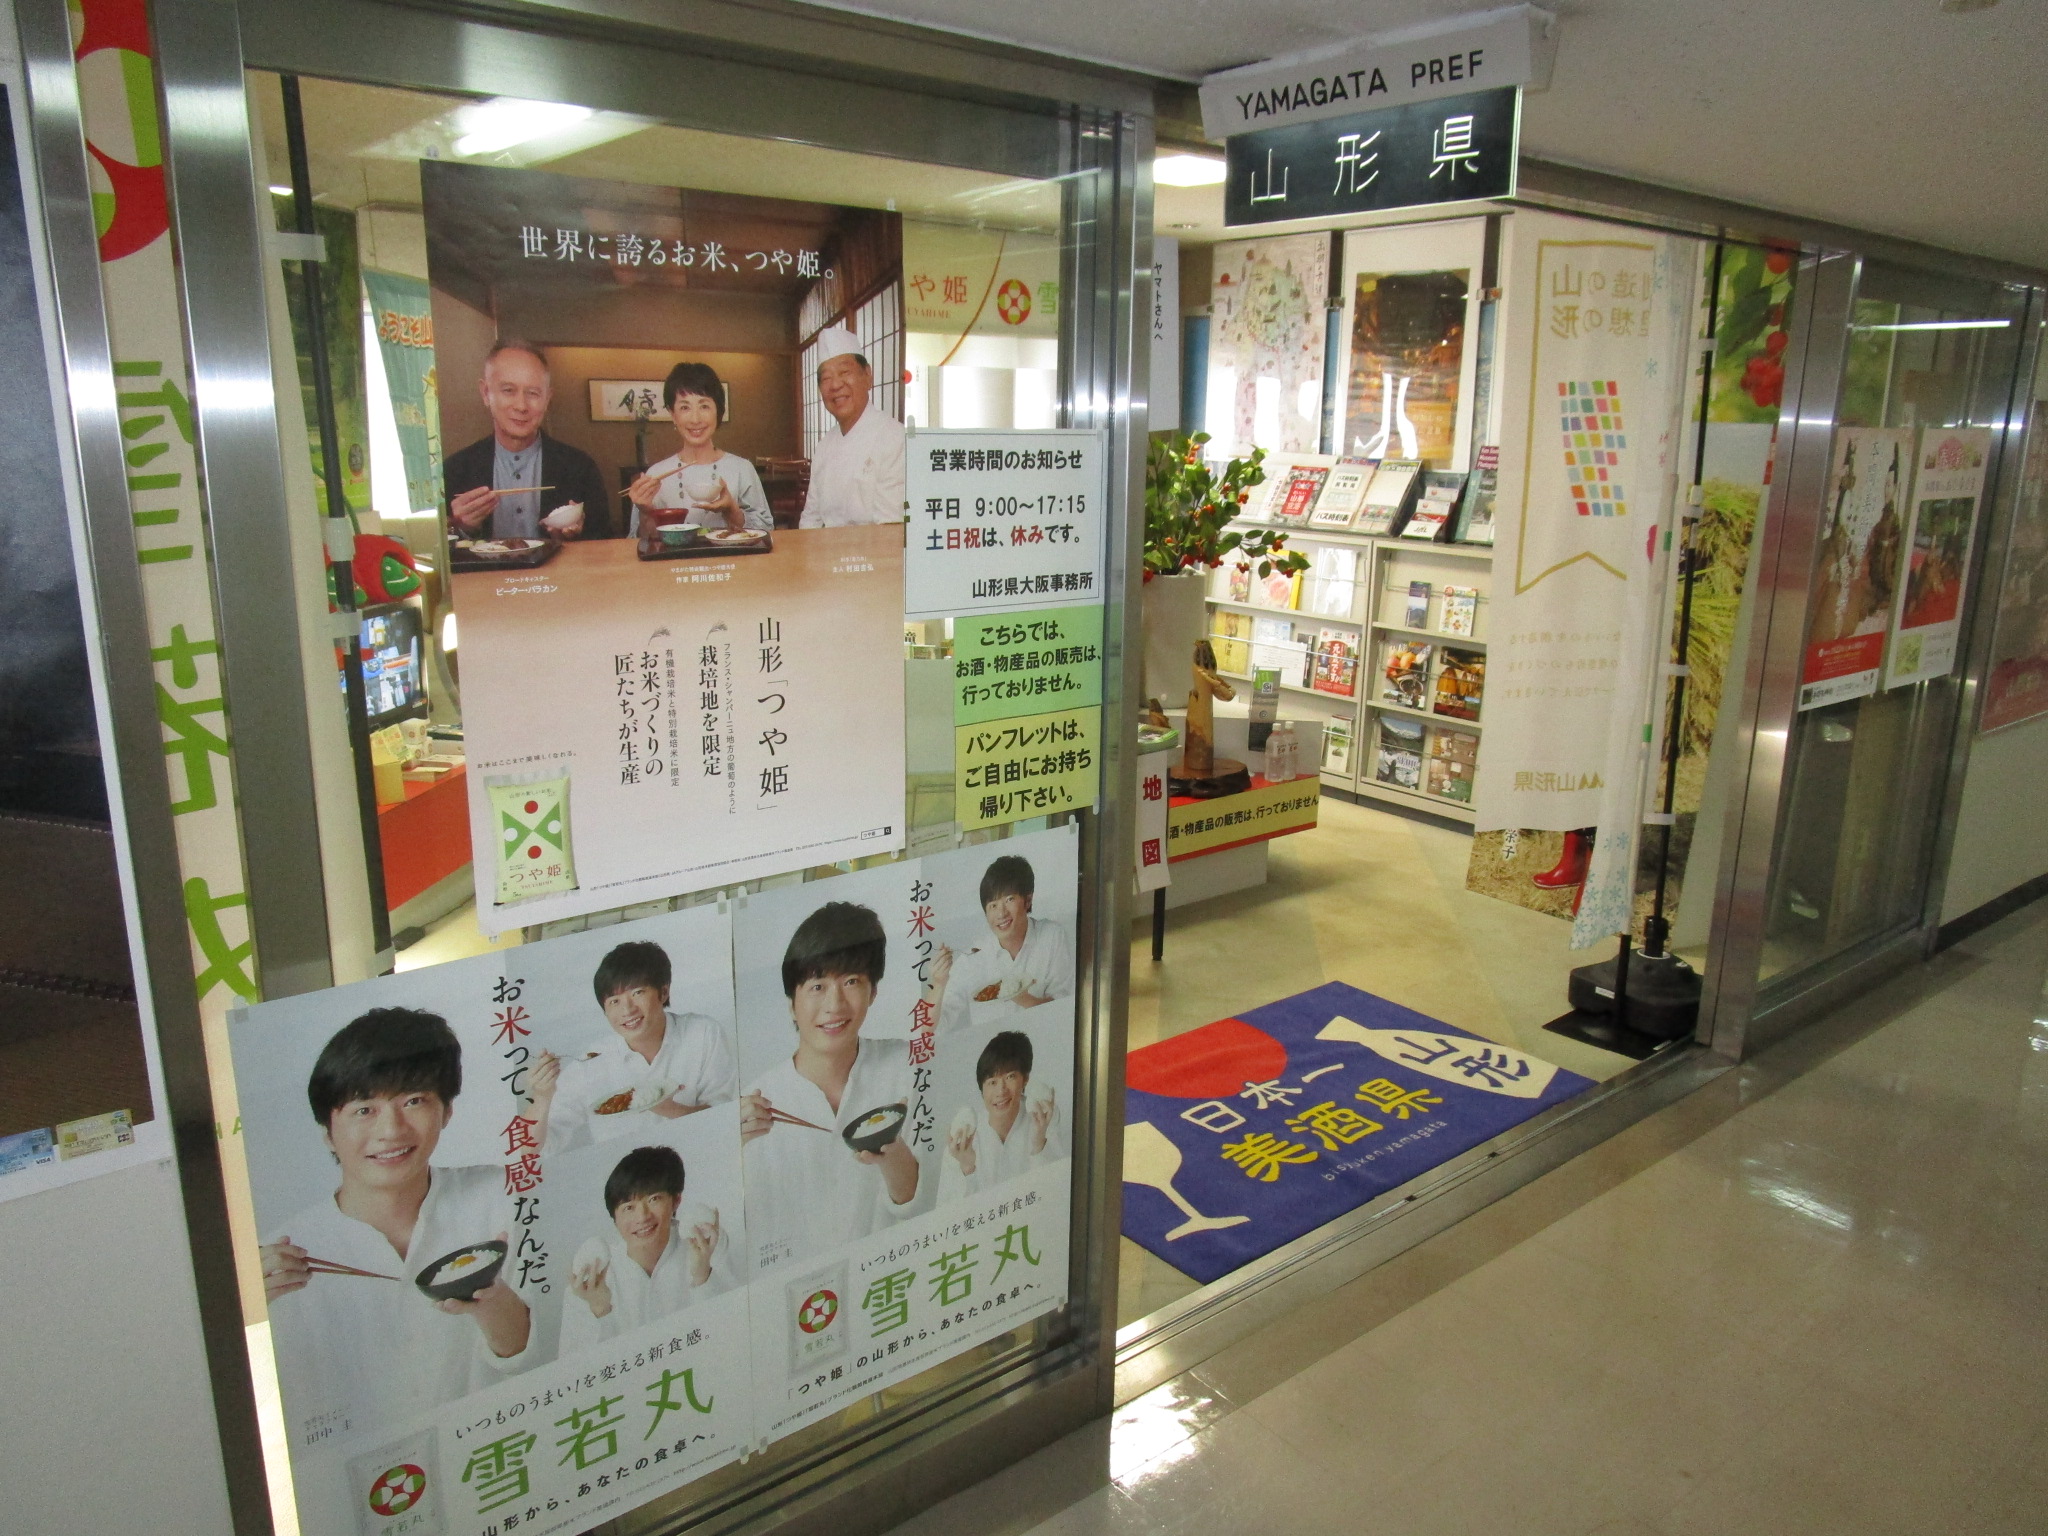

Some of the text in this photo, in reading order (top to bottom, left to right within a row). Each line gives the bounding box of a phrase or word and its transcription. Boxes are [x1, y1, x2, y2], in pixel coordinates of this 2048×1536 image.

[1236, 49, 1484, 120] YAMAGATA PREF
[1250, 114, 1480, 206] 山形県
[518, 225, 835, 280] 世界に誇るお米、つや姫。
[1153, 261, 1164, 341] ヤマトさんへ
[929, 448, 1083, 472] 営業時間のお知らせ
[925, 497, 960, 520] 平日
[1315, 511, 1350, 523] バス時刻表
[925, 523, 1080, 551] 土日祝は、休みです。
[972, 571, 1093, 598] 山形県大阪事務所
[979, 620, 1066, 647] こちらでは、
[956, 645, 1102, 678] お酒・物産品の販売は、
[640, 650, 663, 777] お米づくりの
[698, 644, 722, 778] 栽培地を限定
[756, 616, 790, 811] 山形「つや姫」
[962, 673, 1082, 706] 行っておりません。
[614, 652, 641, 786] 匠たちが生産
[665, 648, 680, 787] 有機栽培米と特別栽培米に限定
[966, 718, 1086, 755] パンフレットは、
[965, 748, 1092, 788] ご自由にお持ち
[979, 785, 1073, 820] 帰り下さい。
[1142, 774, 1163, 868] 地図
[509, 863, 562, 883] つや姫
[906, 879, 936, 1153] お米って、食感なんだ。
[1394, 1035, 1532, 1089] 山形
[1180, 1063, 1345, 1134] 日本一
[489, 975, 552, 1295] お米って、食感なんだ。
[1220, 1077, 1444, 1183] 美酒県
[1385, 1119, 1449, 1154] yamagata
[35, 1157, 51, 1166] VISA
[861, 1223, 1042, 1339] 雪若丸
[460, 1366, 714, 1516] 雪若丸
